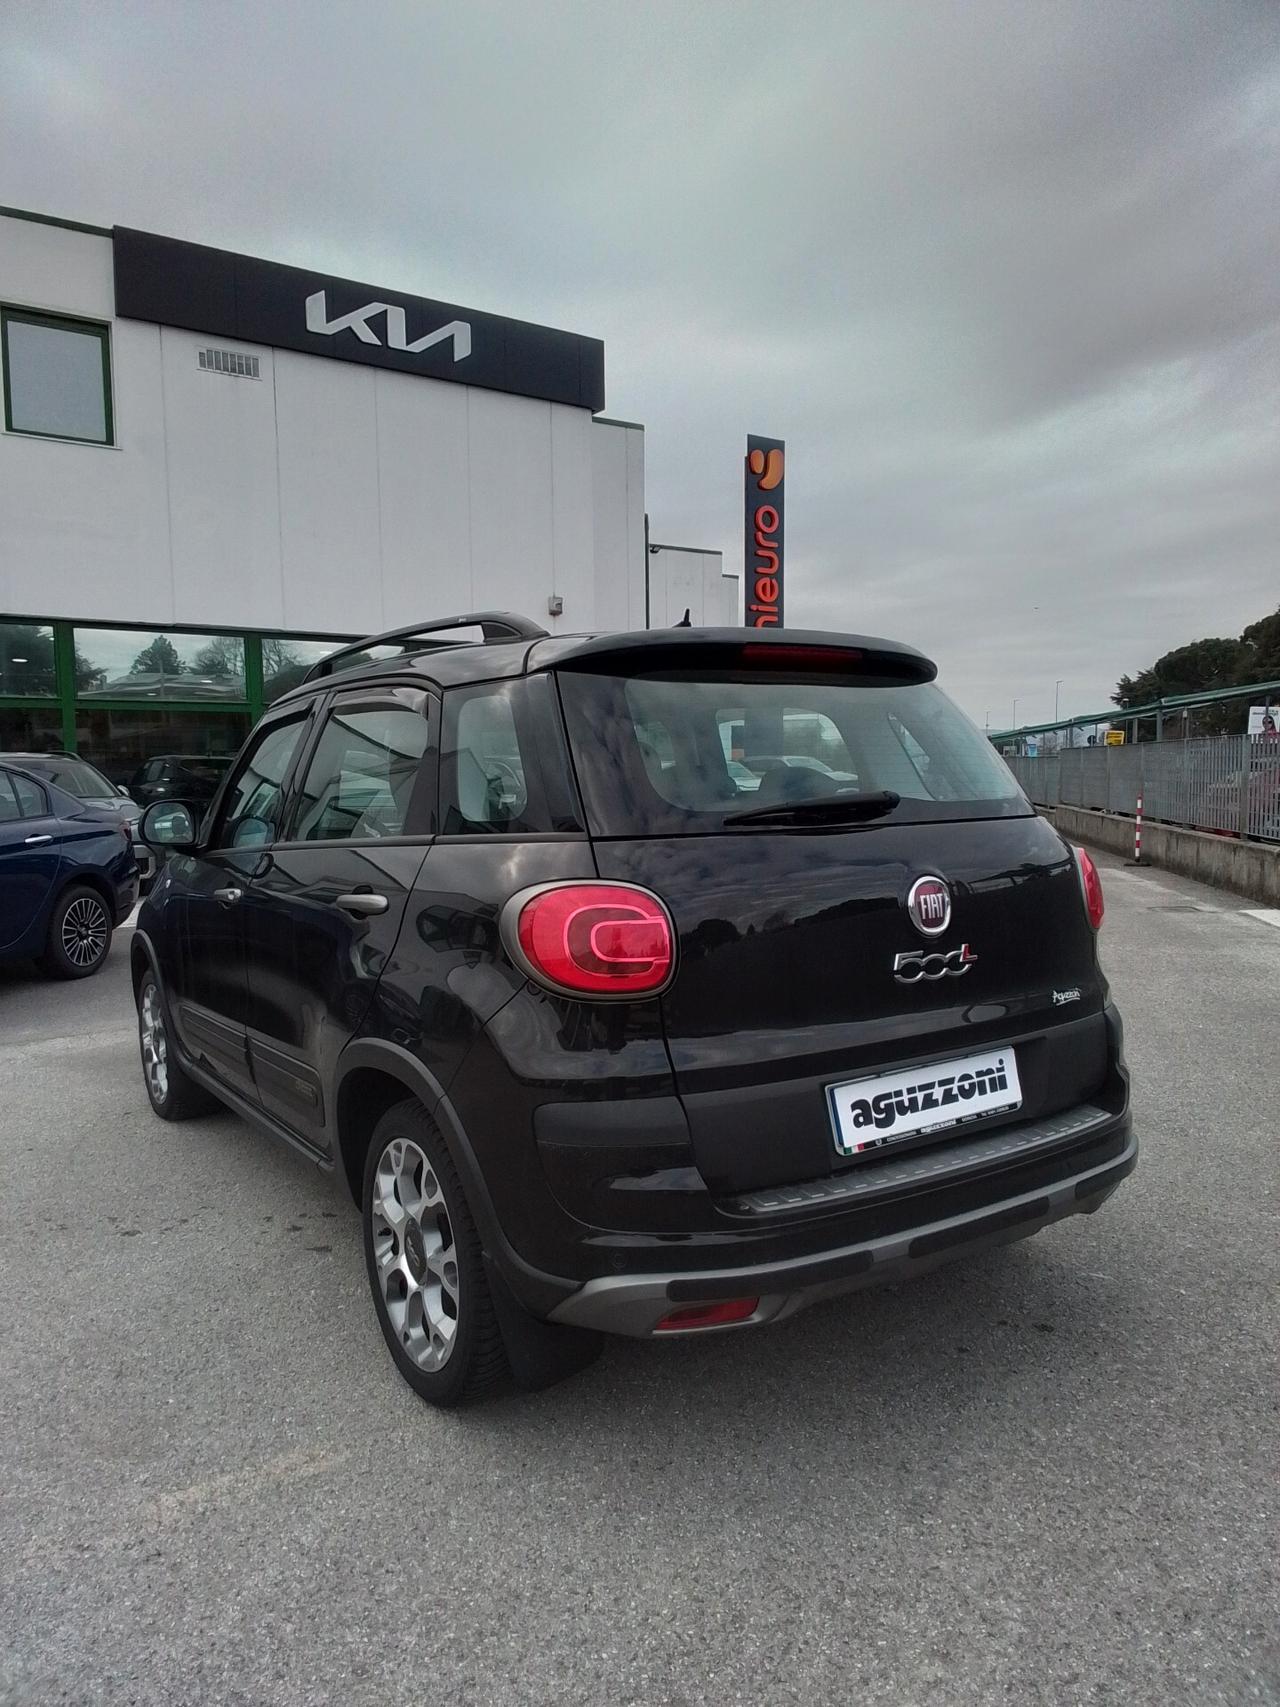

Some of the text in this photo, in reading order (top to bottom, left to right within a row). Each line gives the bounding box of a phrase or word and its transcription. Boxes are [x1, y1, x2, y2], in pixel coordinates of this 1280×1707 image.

[305, 289, 471, 362] KIA
[919, 893, 945, 919] FIAT
[893, 944, 978, 984] 500L
[850, 1058, 1008, 1129] aguzzoni
